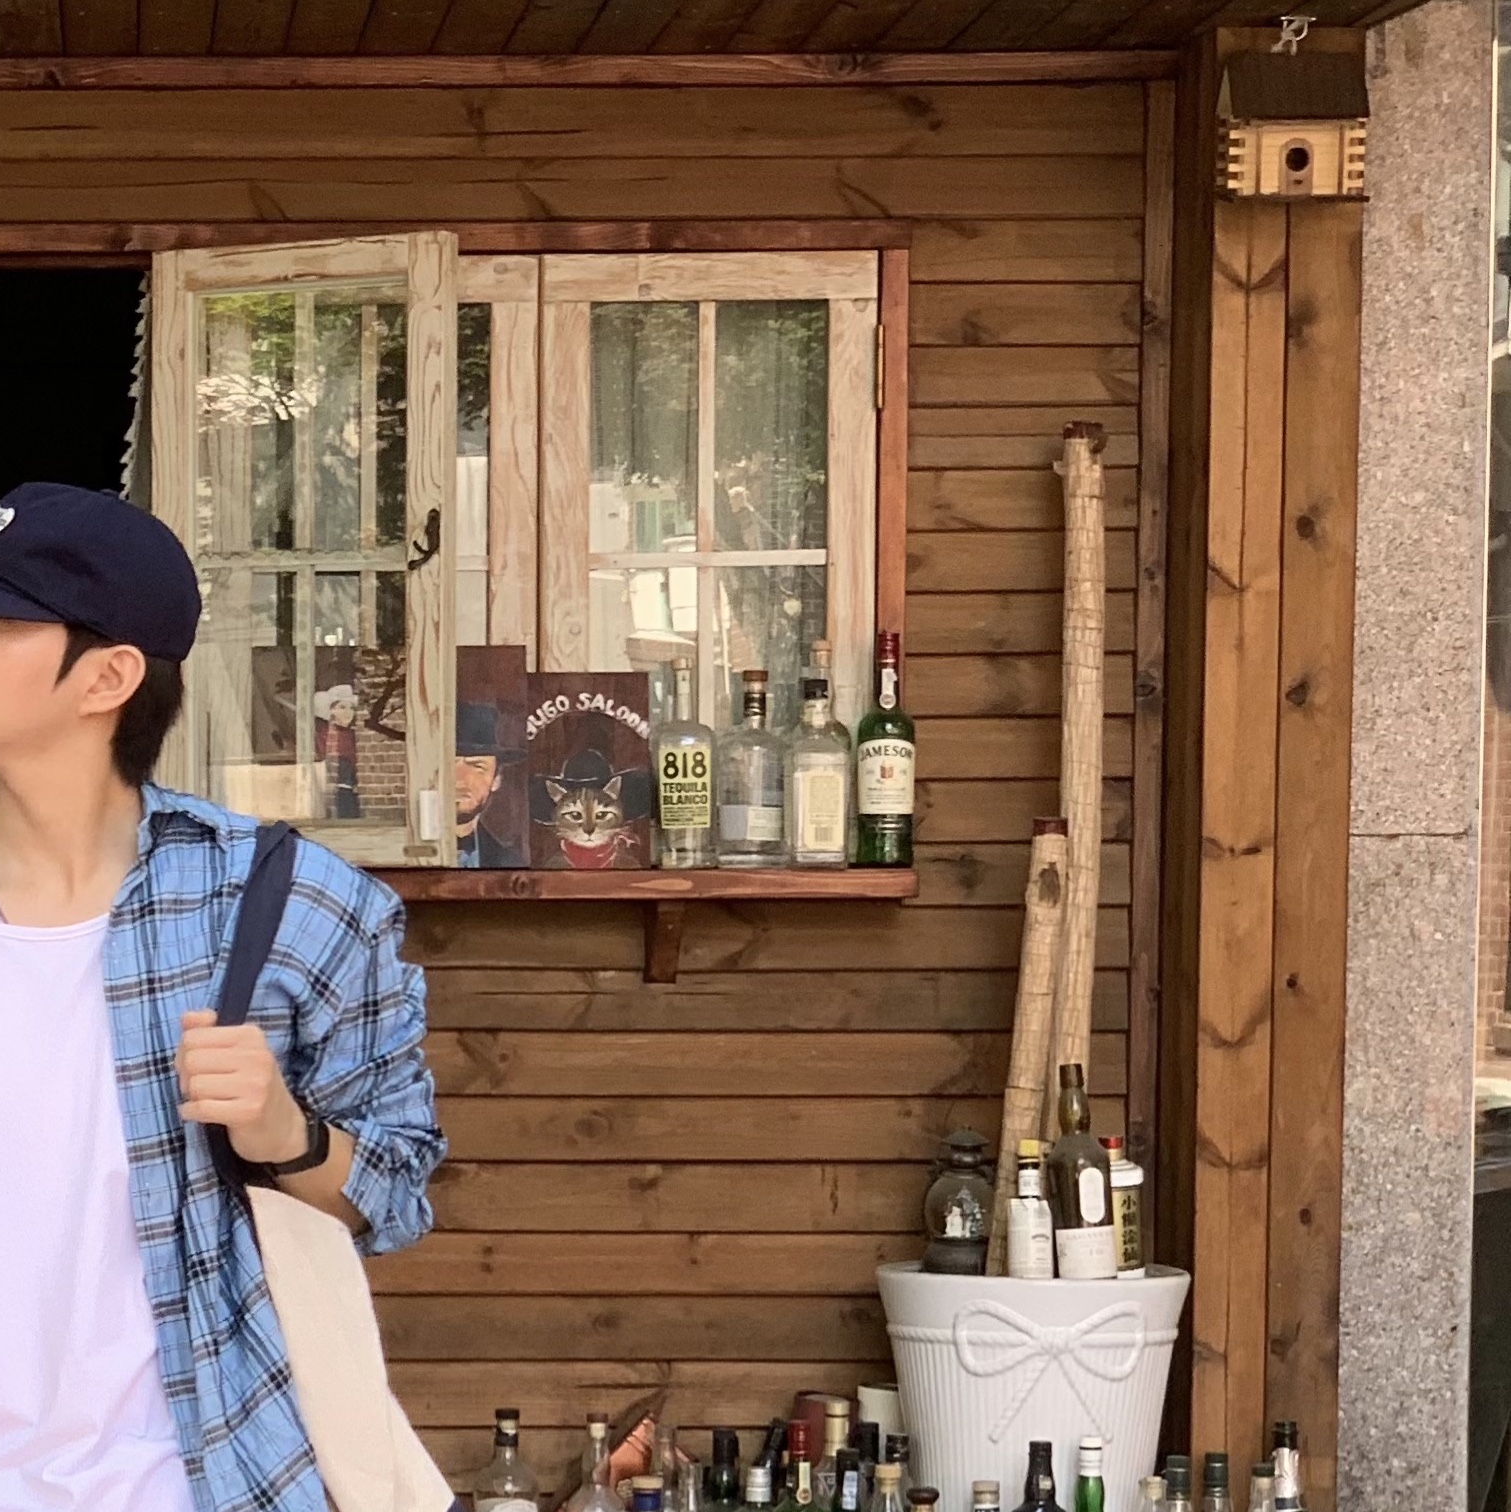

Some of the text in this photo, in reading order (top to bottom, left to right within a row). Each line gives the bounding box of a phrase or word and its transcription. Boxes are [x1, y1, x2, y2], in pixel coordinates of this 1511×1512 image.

[576, 693, 651, 739] SALOON
[860, 745, 913, 762] JAMESON
[663, 752, 707, 779] 818
[662, 782, 708, 794] TEQUILA
[662, 794, 708, 806] BLANCO
